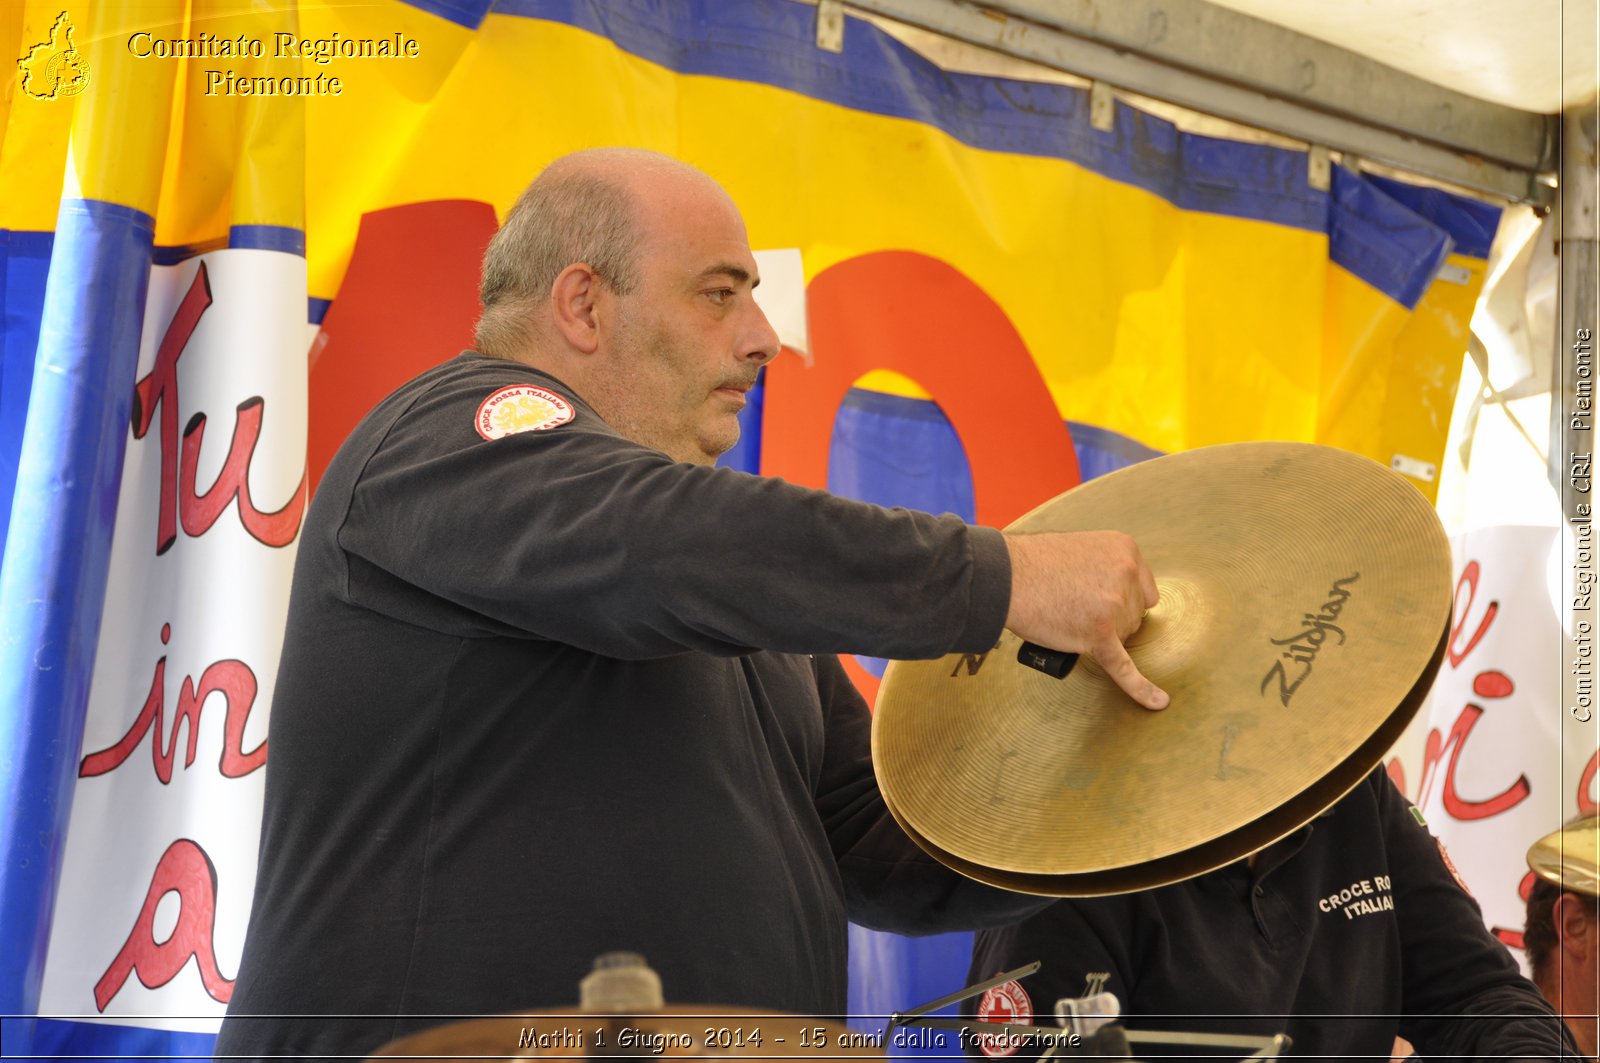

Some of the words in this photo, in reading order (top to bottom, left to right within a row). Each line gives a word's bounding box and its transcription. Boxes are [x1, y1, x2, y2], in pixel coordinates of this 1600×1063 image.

[482, 408, 493, 432] CROCE
[490, 389, 521, 407] ROSSA
[1260, 570, 1361, 708] Zildjian
[1318, 880, 1374, 913] CROCE
